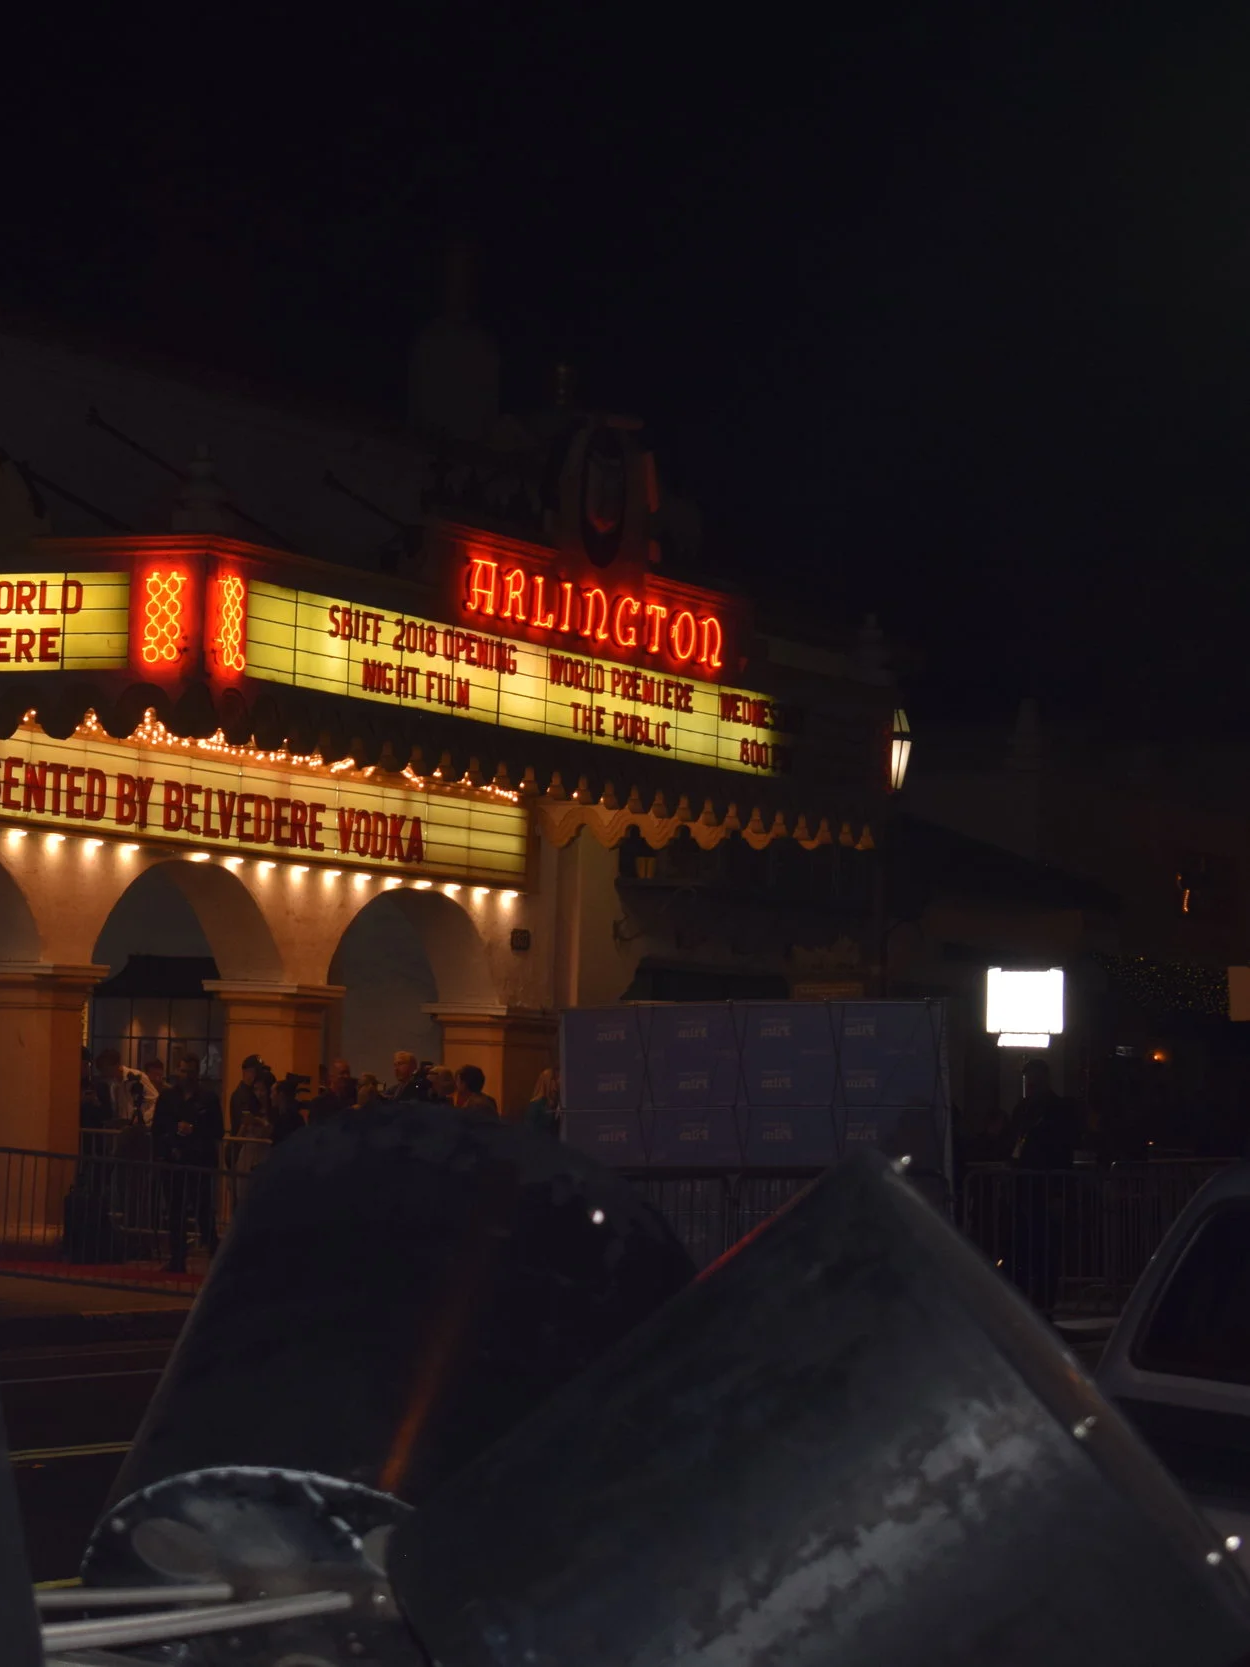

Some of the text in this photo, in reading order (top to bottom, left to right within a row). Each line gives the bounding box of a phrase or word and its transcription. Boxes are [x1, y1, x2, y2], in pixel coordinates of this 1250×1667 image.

[328, 604, 518, 676] SBIFF 2018 OPENING
[465, 558, 722, 668] ARLINGTON
[361, 657, 470, 711] NIGHT FILM
[549, 653, 695, 714] WORLD PREMIERE
[570, 701, 672, 751] THE PUBLIC
[115, 772, 155, 829] BY
[162, 779, 327, 852] BELVEDERE
[337, 806, 425, 865] VODKA
